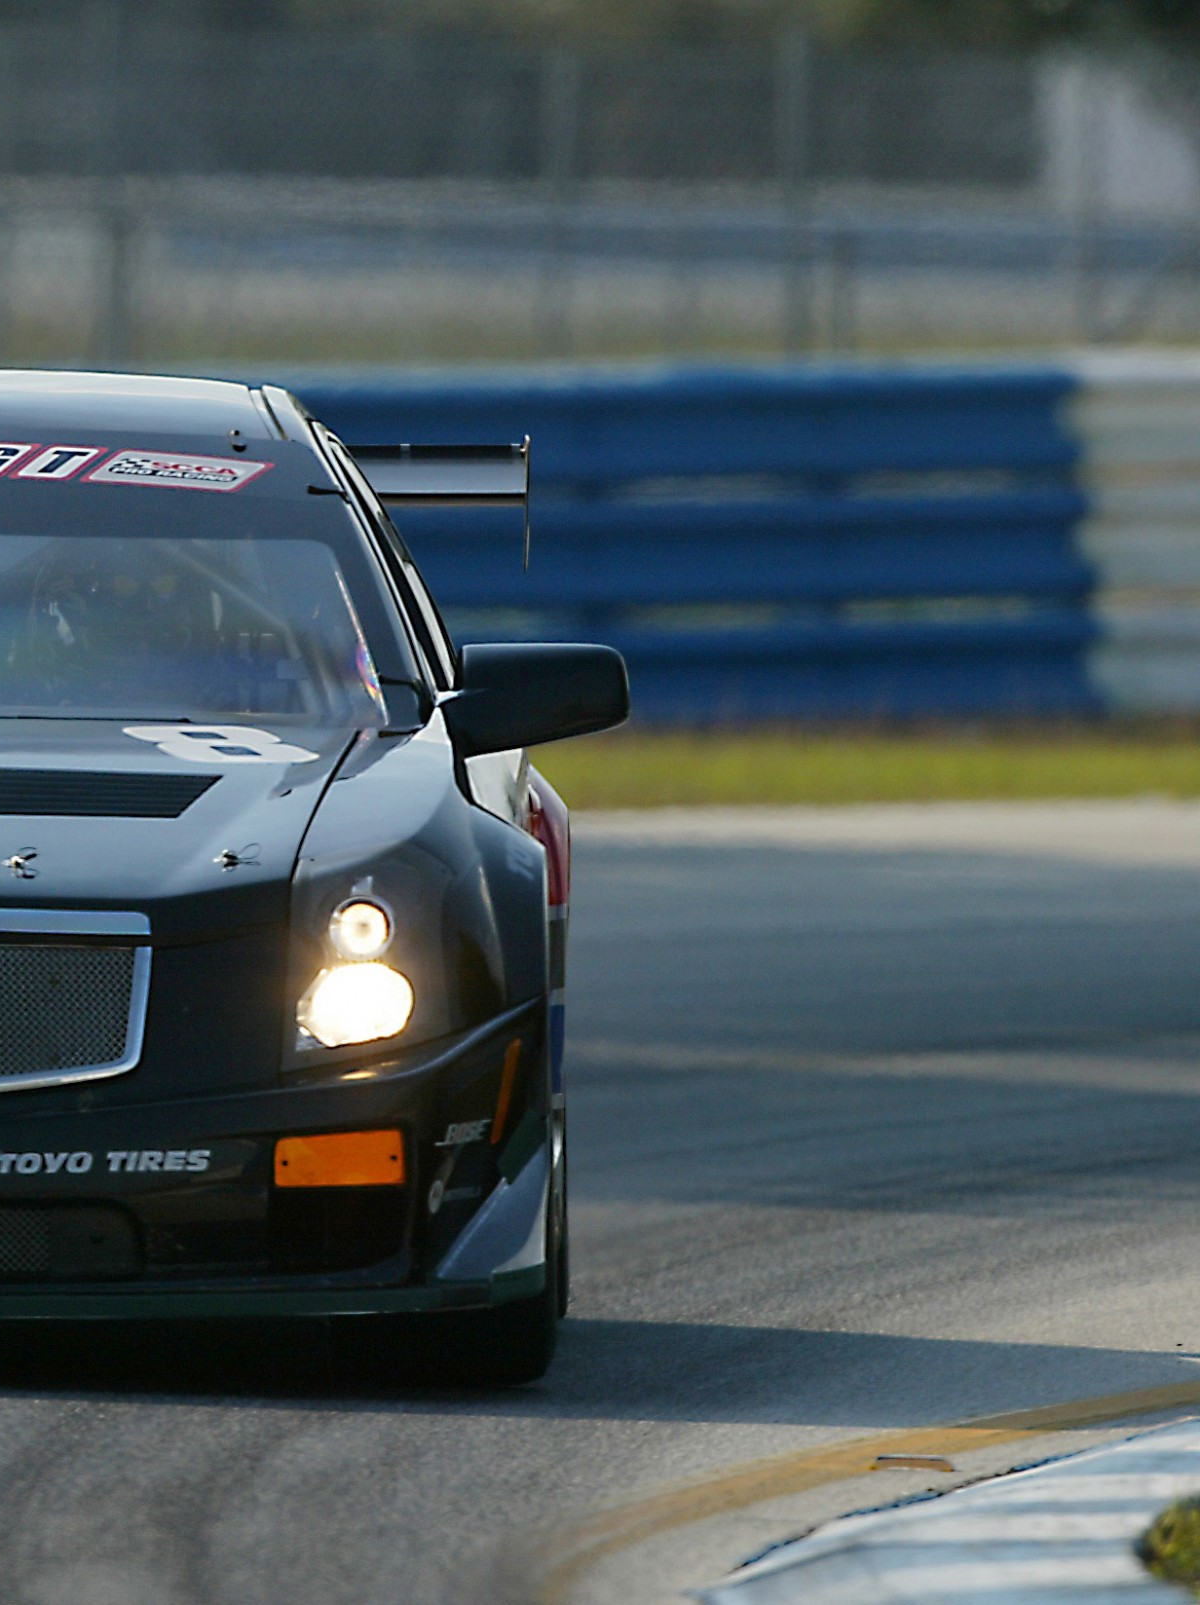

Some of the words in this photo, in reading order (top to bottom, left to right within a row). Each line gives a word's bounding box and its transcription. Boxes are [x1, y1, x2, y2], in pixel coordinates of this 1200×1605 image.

[112, 466, 152, 476] PRO
[157, 469, 235, 482] RACING
[152, 462, 236, 474] SCCA
[122, 725, 320, 764] 8
[107, 1149, 211, 1173] TIRES
